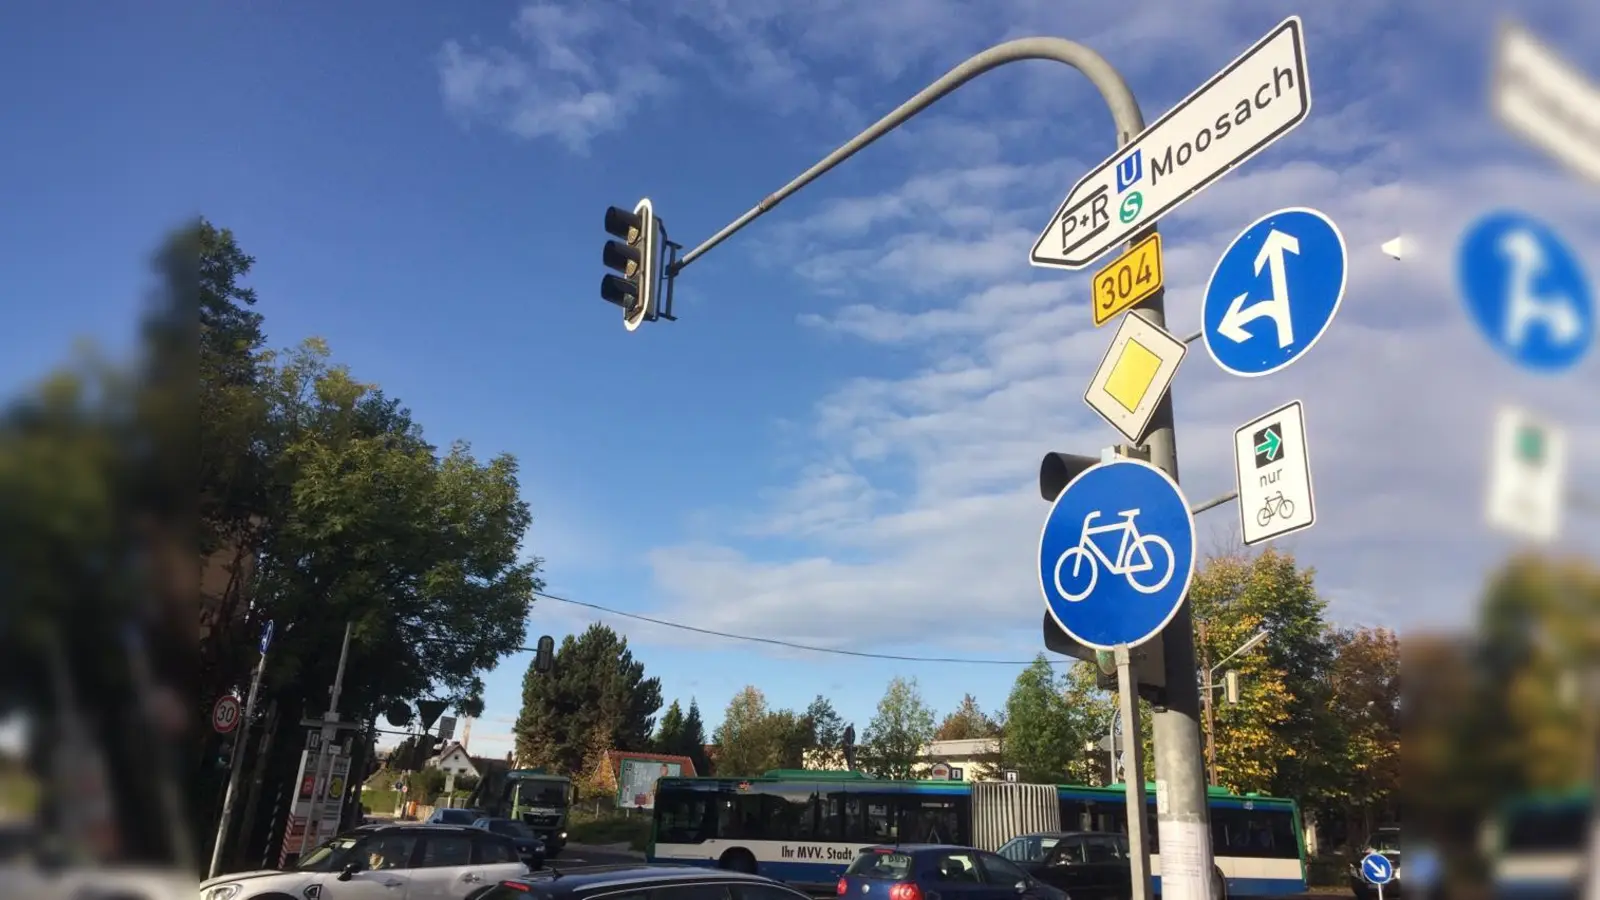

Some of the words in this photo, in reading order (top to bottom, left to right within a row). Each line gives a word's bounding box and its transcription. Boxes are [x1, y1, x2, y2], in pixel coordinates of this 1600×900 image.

[1151, 66, 1294, 185] Moosach
[1119, 152, 1139, 186] U
[1061, 194, 1110, 248] P+R
[1122, 193, 1140, 220] S
[1101, 252, 1152, 310] 304
[1260, 468, 1283, 487] nur
[217, 705, 235, 723] 30
[781, 845, 794, 858] Ihr
[798, 846, 824, 859] MVV.
[827, 847, 855, 862] Stadt,
